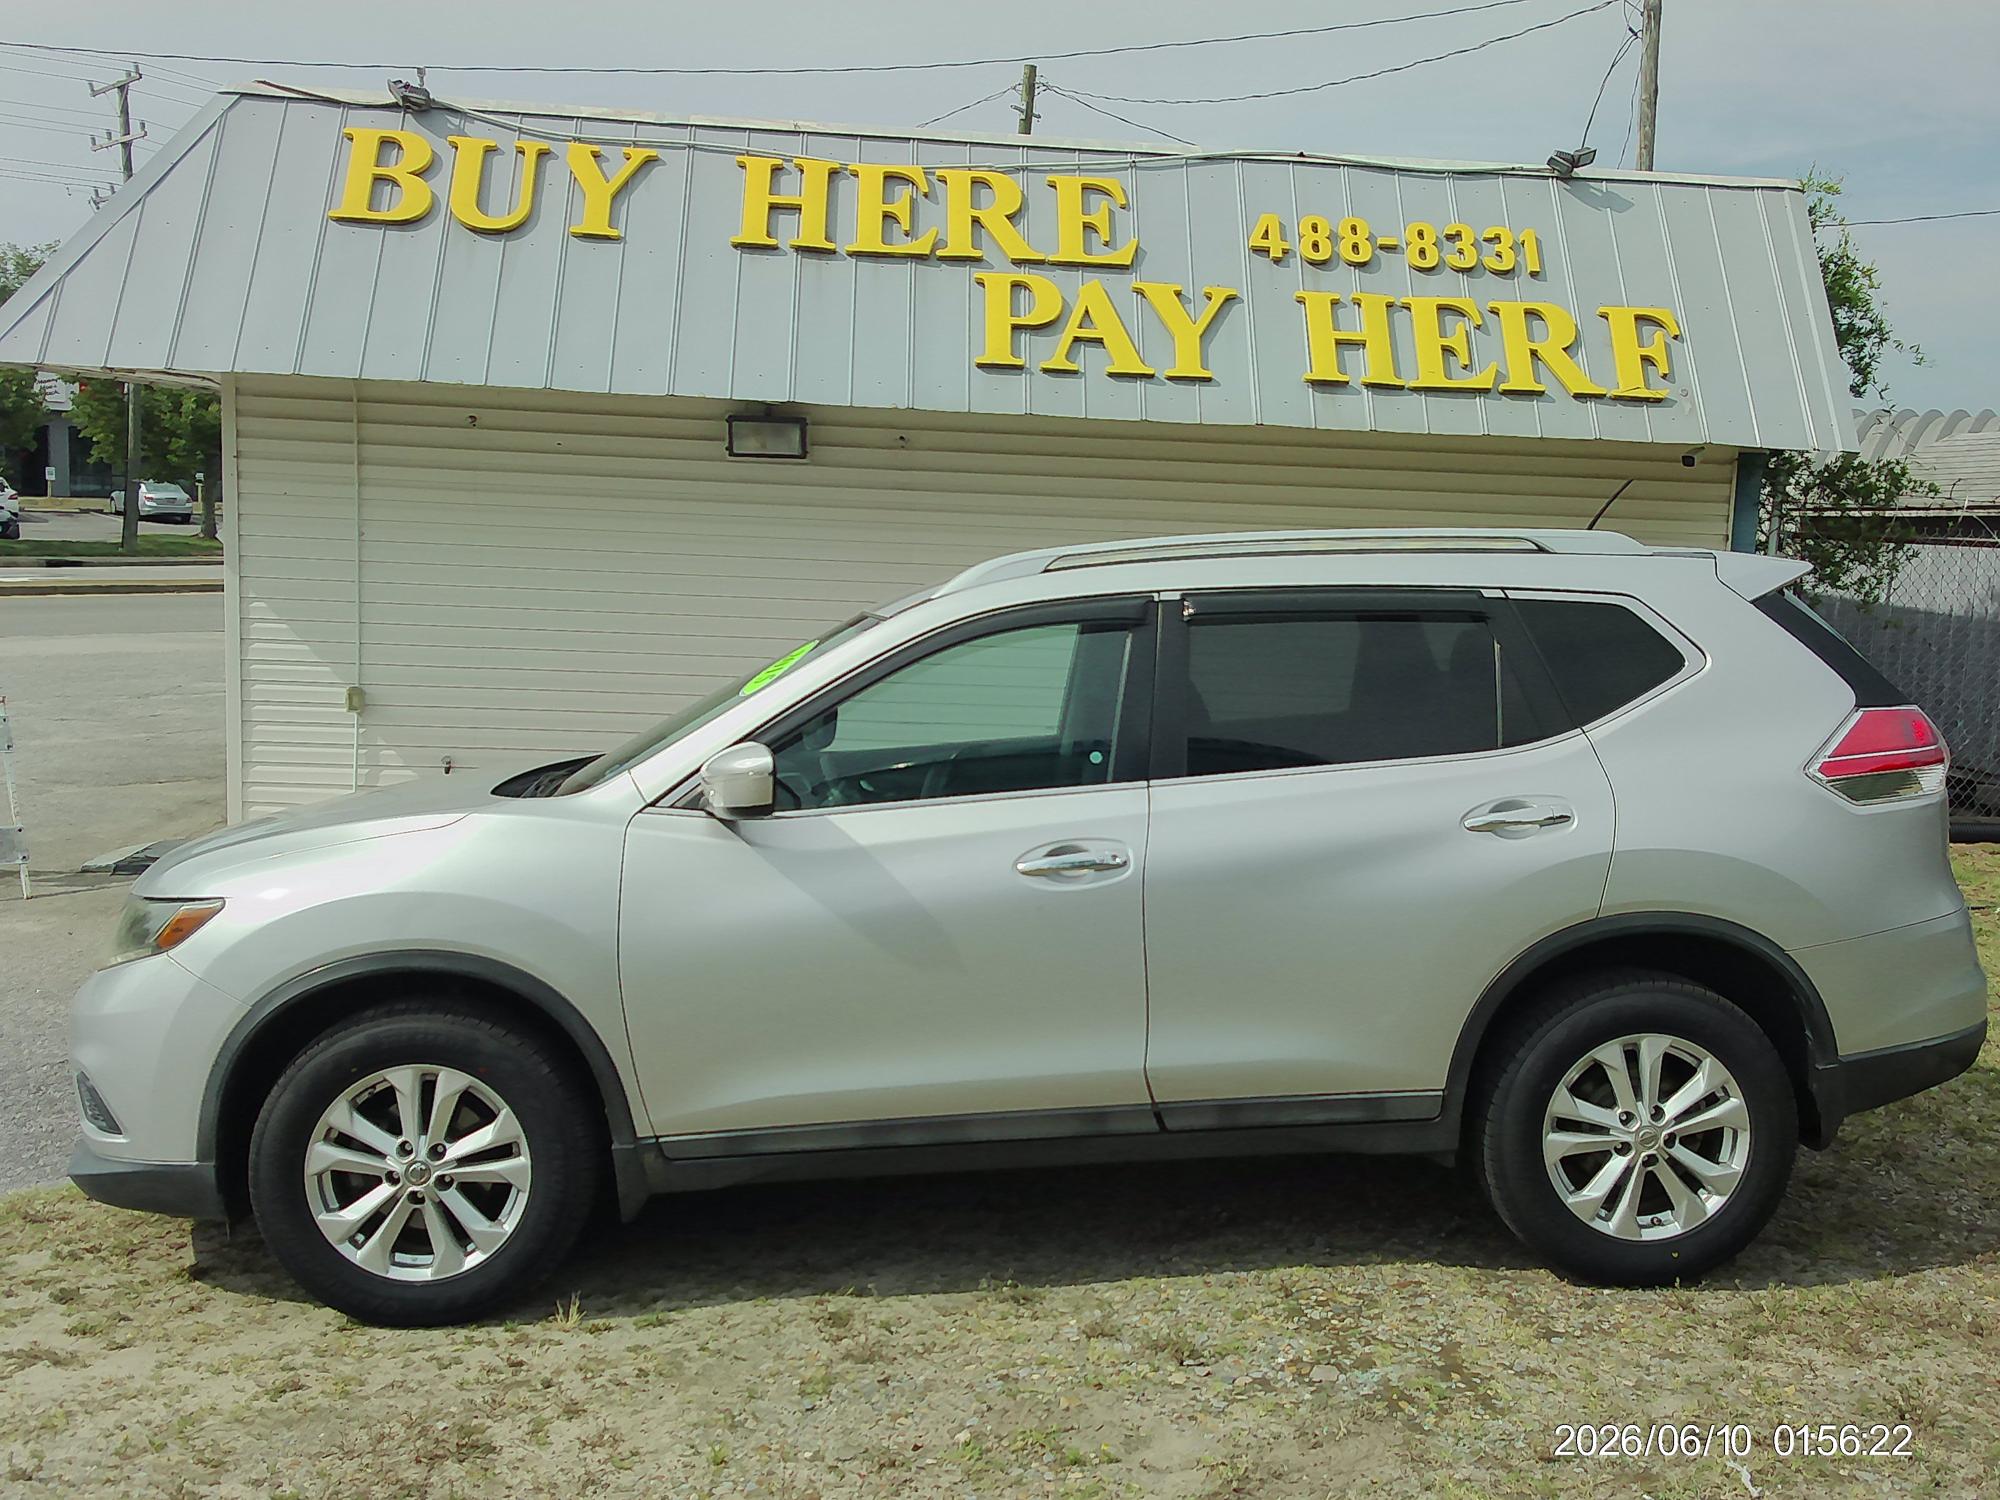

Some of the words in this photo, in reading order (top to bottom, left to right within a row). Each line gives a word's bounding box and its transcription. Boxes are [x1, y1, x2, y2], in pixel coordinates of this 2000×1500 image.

[328, 126, 660, 241] BUY
[731, 153, 1140, 268] HERE
[1249, 212, 1542, 275] 488-8331
[975, 271, 1239, 381] PAY
